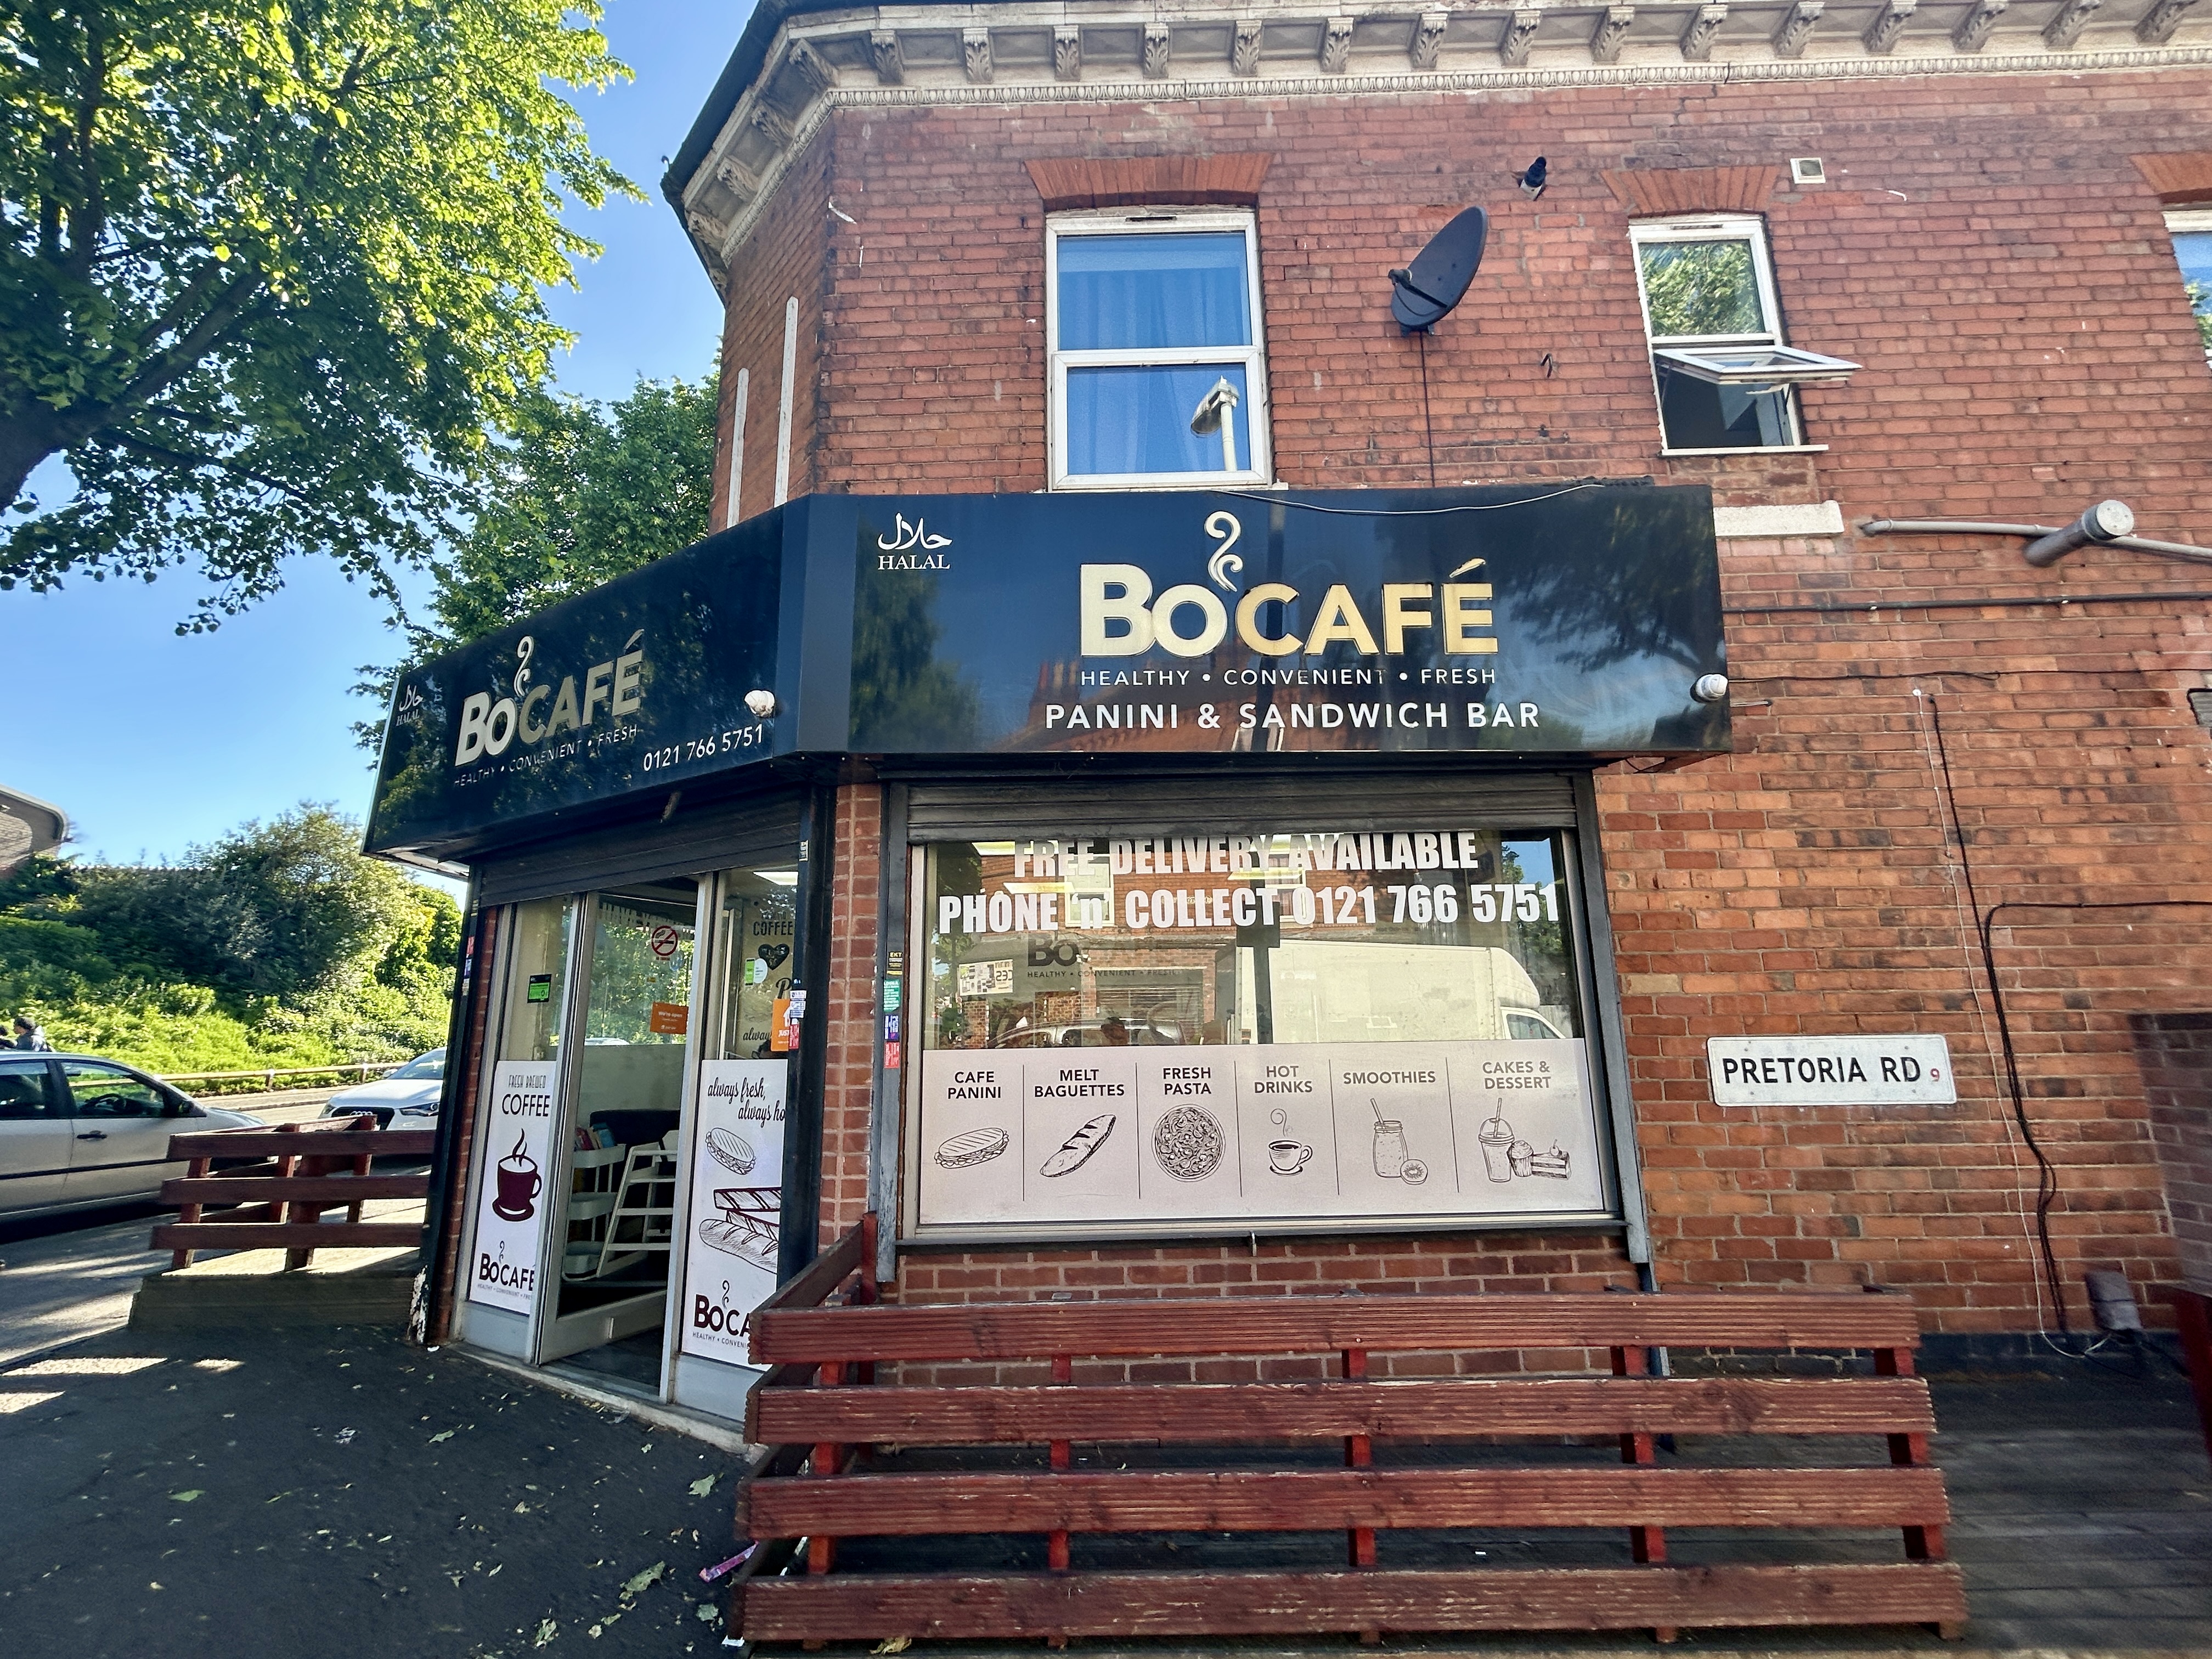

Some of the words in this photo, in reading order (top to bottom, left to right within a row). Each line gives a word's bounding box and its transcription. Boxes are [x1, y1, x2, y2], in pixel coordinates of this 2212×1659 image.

[878, 512, 952, 550] حلال
[878, 555, 950, 570] HALAL
[1081, 670, 1189, 686] HEALTHY
[1224, 669, 1385, 686] CONVENIENT
[1421, 668, 1496, 685] FRESH
[399, 684, 423, 712] حلال
[396, 709, 420, 726] HALAL
[1046, 704, 1177, 730] PANINI
[1198, 703, 1221, 729] &
[1239, 703, 1448, 730] SANDWICH
[1468, 702, 1539, 728] BAR
[644, 745, 679, 771] 0121
[687, 736, 716, 761] 766
[721, 724, 763, 752] 5751
[454, 767, 494, 787] HEALTHY
[509, 740, 582, 772] CONVENIENT
[598, 724, 637, 748] FRESH
[1014, 840, 1095, 878] FREE
[1109, 834, 1273, 874] DELIVERY
[1289, 831, 1478, 871] AVAILABLE
[939, 893, 1058, 934] PHONE
[1125, 887, 1278, 928] COLLECT
[1291, 885, 1375, 926] 0121
[1387, 884, 1458, 924] 766
[1472, 883, 1559, 923] 5751
[753, 921, 793, 936] COFFEE
[743, 1027, 771, 1041] alway
[1163, 1067, 1211, 1080] FRESH
[1266, 1065, 1299, 1078] HOT
[1482, 1062, 1533, 1074] CAKES
[1539, 1060, 1550, 1073] &
[1723, 1057, 1867, 1084] PRETORIA
[1881, 1057, 1920, 1082] RD
[1929, 1068, 1940, 1082] 9
[526, 1075, 546, 1088] BREWED
[954, 1071, 995, 1084] CAFE
[1059, 1069, 1099, 1081] MELT
[1343, 1071, 1436, 1085] SMOOTHIES
[708, 1076, 739, 1104] always
[741, 1077, 765, 1103] fresh,
[1034, 1084, 1125, 1097] BAGUETTES
[1164, 1082, 1211, 1095] PASTA
[1254, 1081, 1313, 1094] DRINKS
[1485, 1076, 1551, 1090] DESSERT
[947, 1086, 1001, 1099] PANINI
[502, 1093, 550, 1117] COFFEE
[738, 1099, 772, 1128] always
[773, 1099, 786, 1121] ho
[693, 1294, 751, 1337] BOCA
[692, 1331, 715, 1342] HEALTHY
